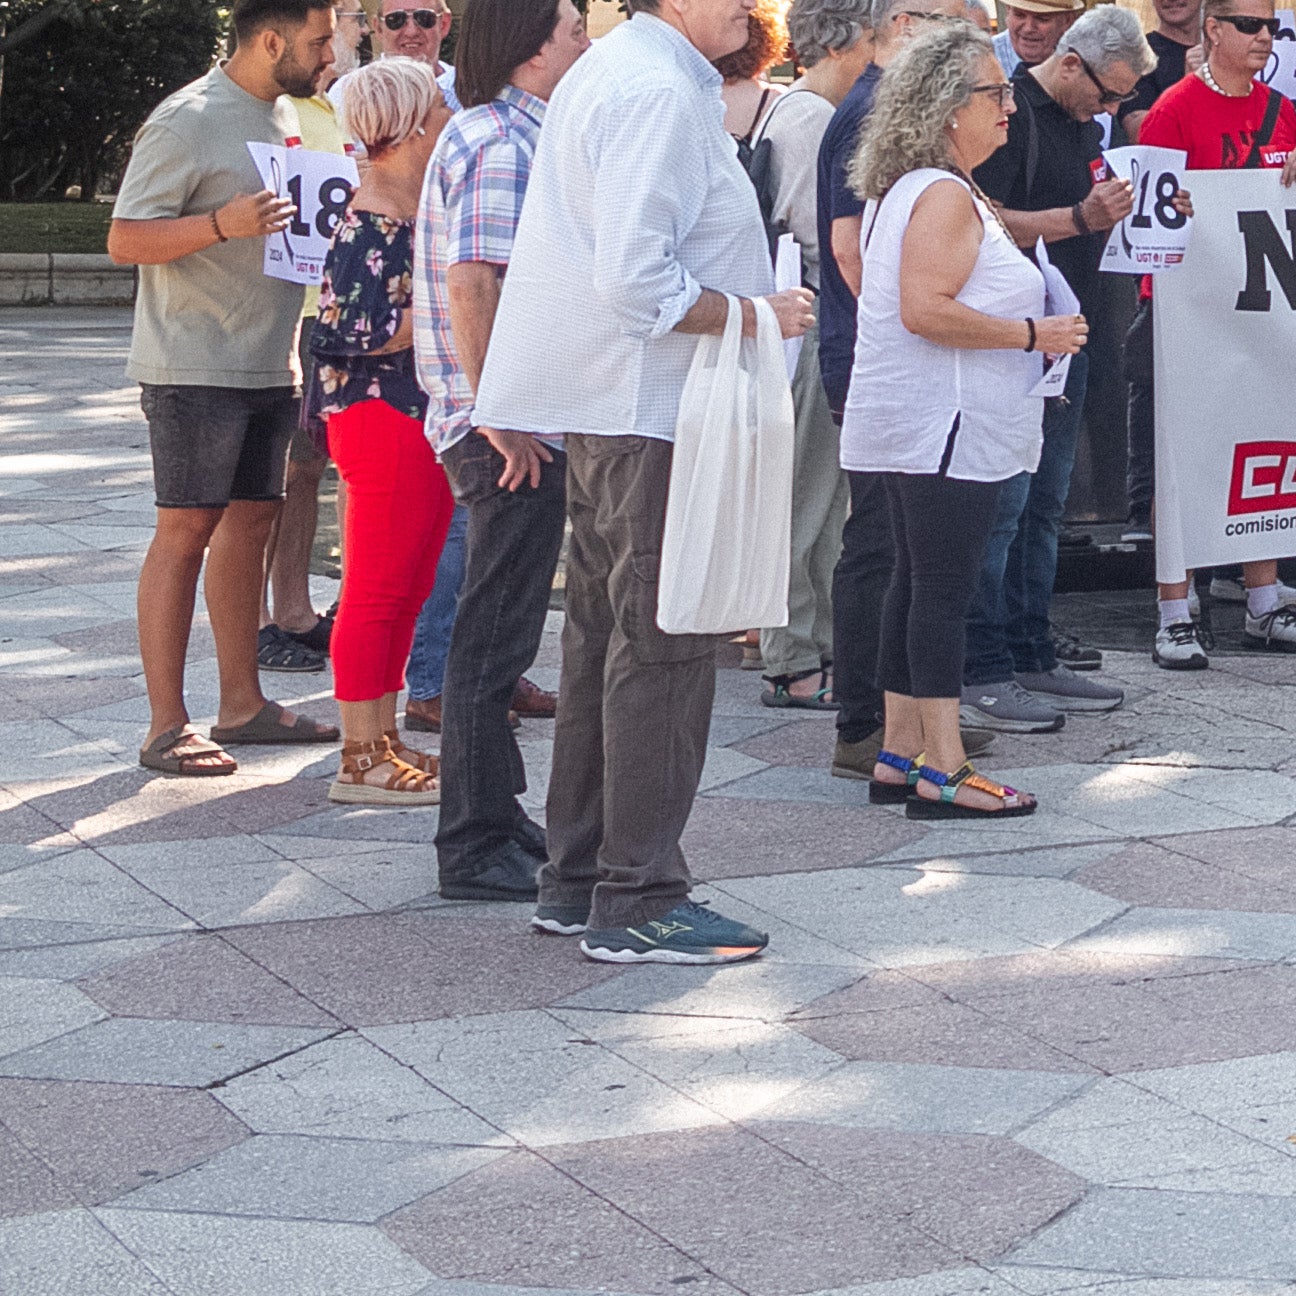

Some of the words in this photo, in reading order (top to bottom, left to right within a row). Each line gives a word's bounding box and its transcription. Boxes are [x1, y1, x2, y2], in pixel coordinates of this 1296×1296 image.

[1264, 151, 1287, 164] UGT
[287, 174, 353, 239] 18
[1130, 170, 1187, 229] 18
